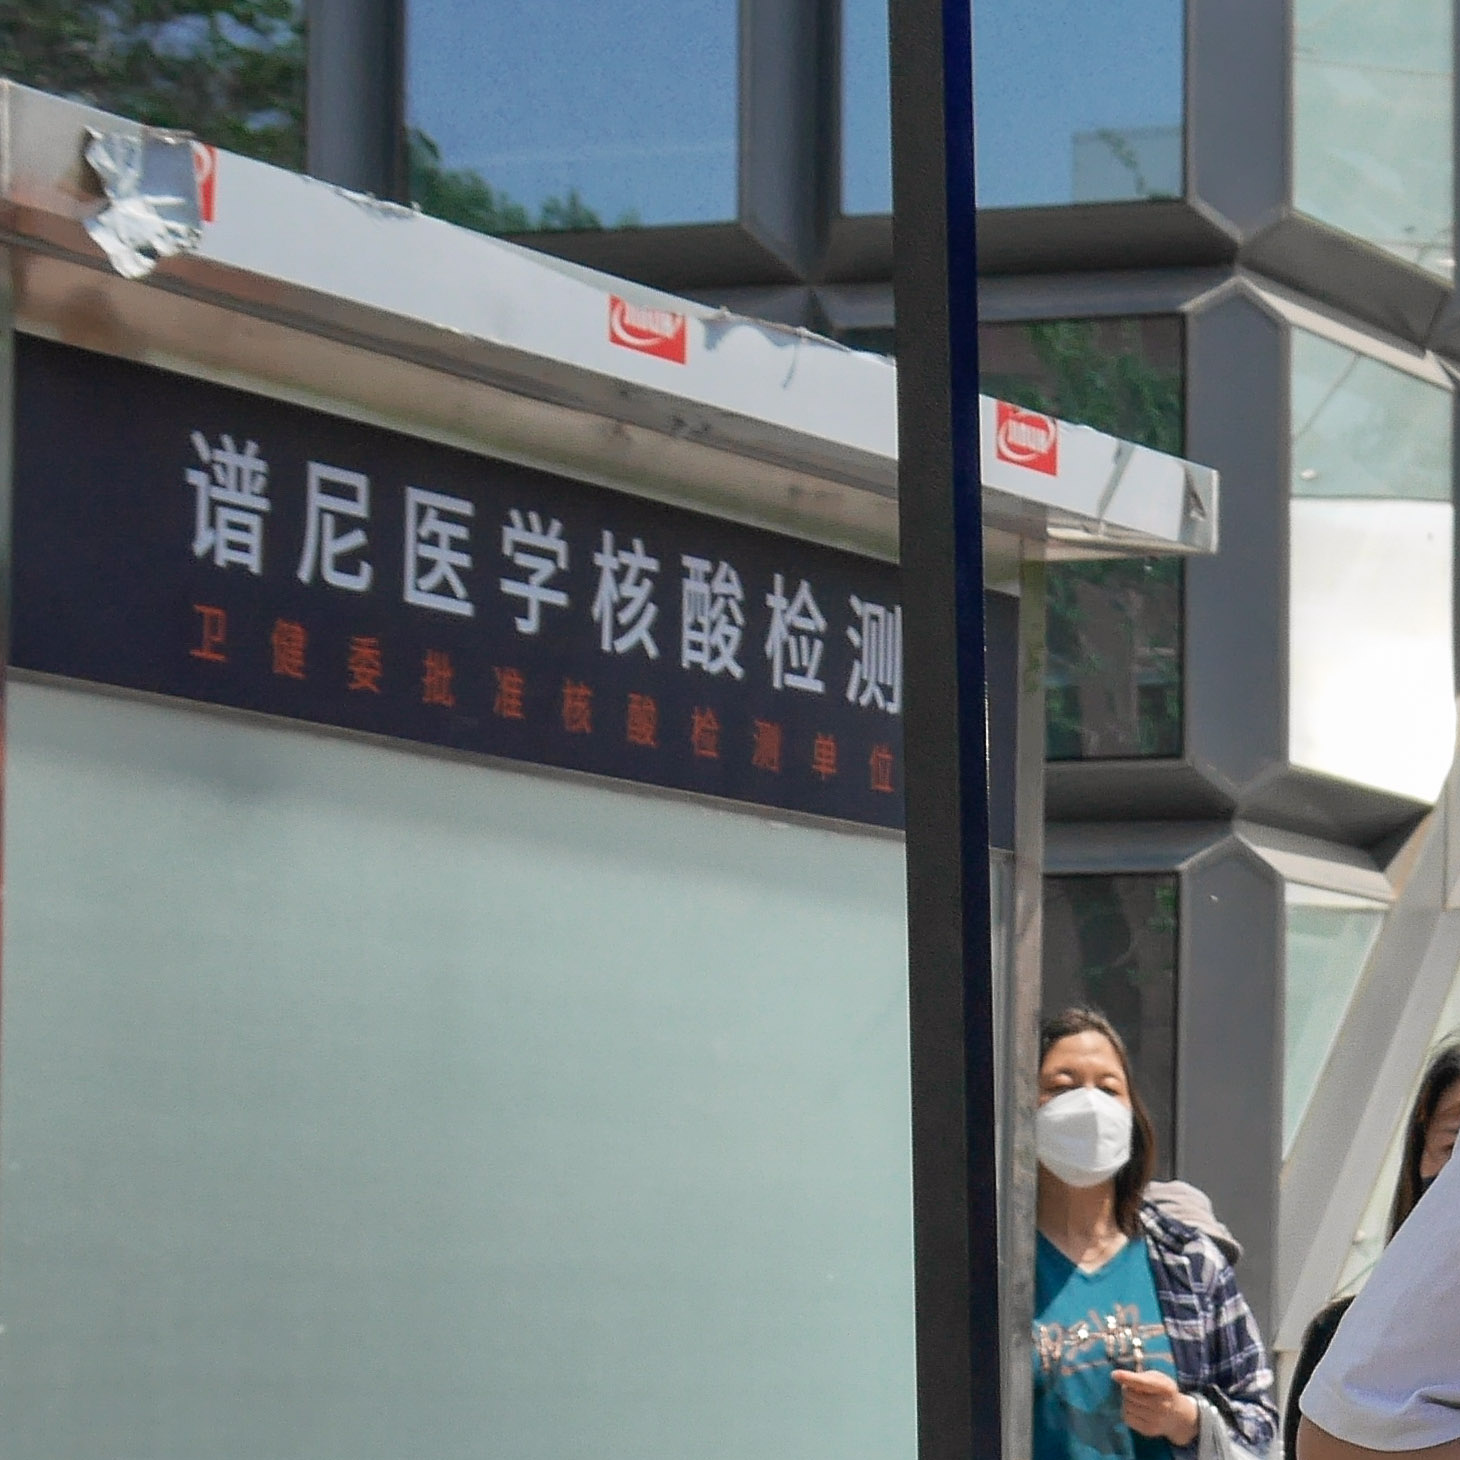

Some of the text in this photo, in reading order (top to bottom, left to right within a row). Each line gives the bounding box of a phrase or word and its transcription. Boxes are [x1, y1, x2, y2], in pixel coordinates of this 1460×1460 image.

[185, 430, 902, 715] 谱尼医学核酸检测
[189, 604, 895, 794] 卫健委批准核酸检测单位
